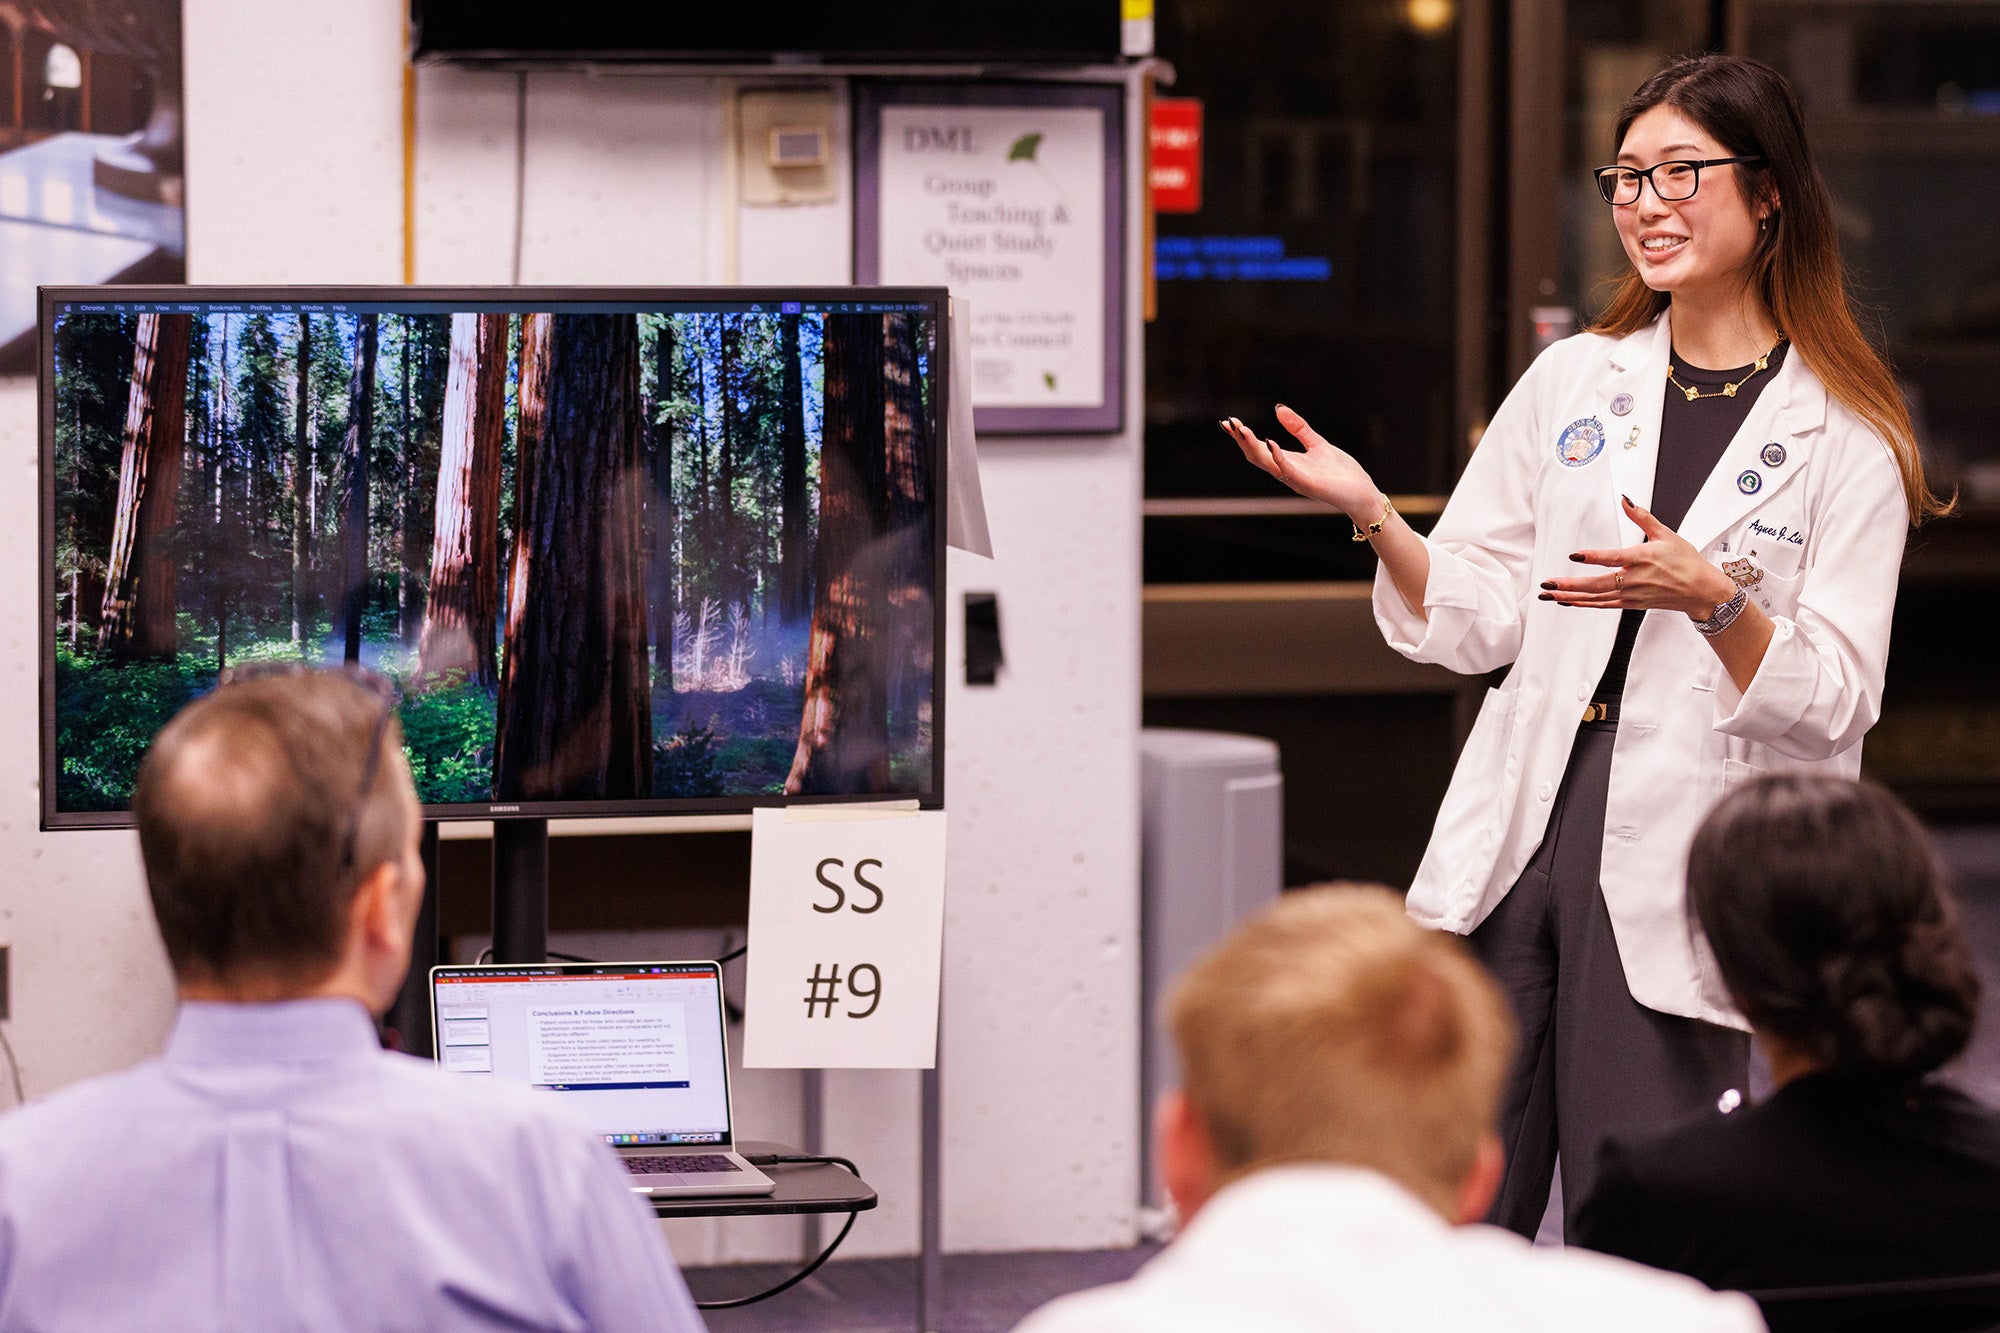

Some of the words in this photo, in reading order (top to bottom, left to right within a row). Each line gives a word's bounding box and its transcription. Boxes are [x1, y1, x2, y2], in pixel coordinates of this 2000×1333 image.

[903, 125, 983, 154] DML
[922, 172, 997, 199] Group
[947, 201, 1045, 228] Teaching
[922, 228, 986, 255] Quiet
[993, 231, 1055, 260] Study
[80, 304, 105, 312] Chrome
[114, 304, 125, 312] File
[134, 304, 147, 312] Edit
[155, 304, 170, 312] View
[178, 304, 200, 313] History
[209, 304, 241, 312] Bookmarks
[250, 304, 272, 312] Profiles
[281, 304, 293, 312] Tab
[301, 304, 324, 312] Window
[333, 304, 347, 313] Help
[1748, 518, 1777, 536] Agnes
[1786, 531, 1804, 545] Lin
[812, 857, 884, 914] SS
[803, 963, 882, 1019] #9
